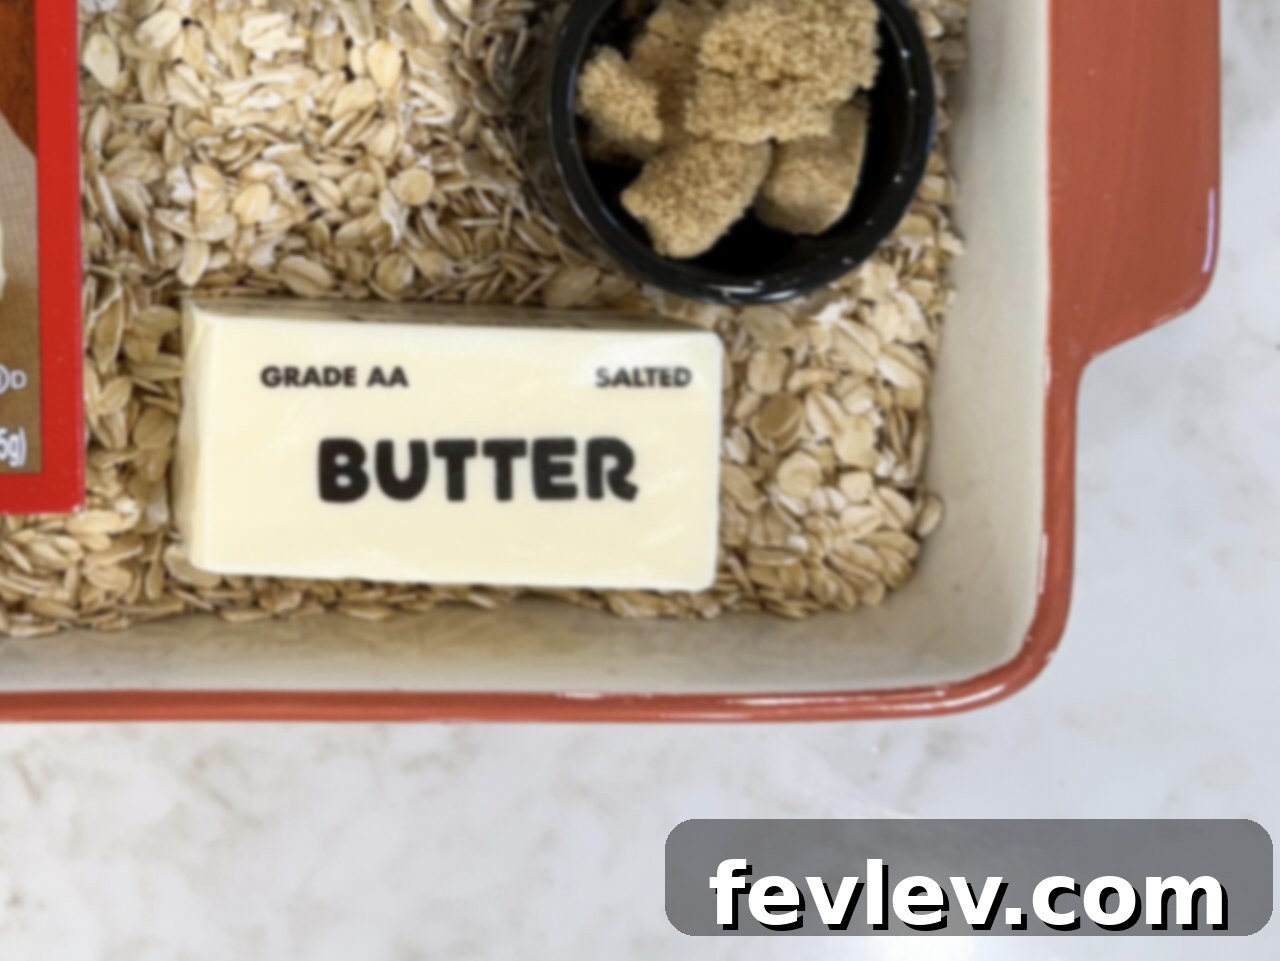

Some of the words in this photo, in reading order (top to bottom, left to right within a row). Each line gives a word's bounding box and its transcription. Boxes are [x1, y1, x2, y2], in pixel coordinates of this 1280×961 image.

[260, 366, 357, 389] GRADE
[366, 366, 409, 388] AA
[595, 366, 693, 389] SALTED
[317, 436, 640, 504] BUTTER
